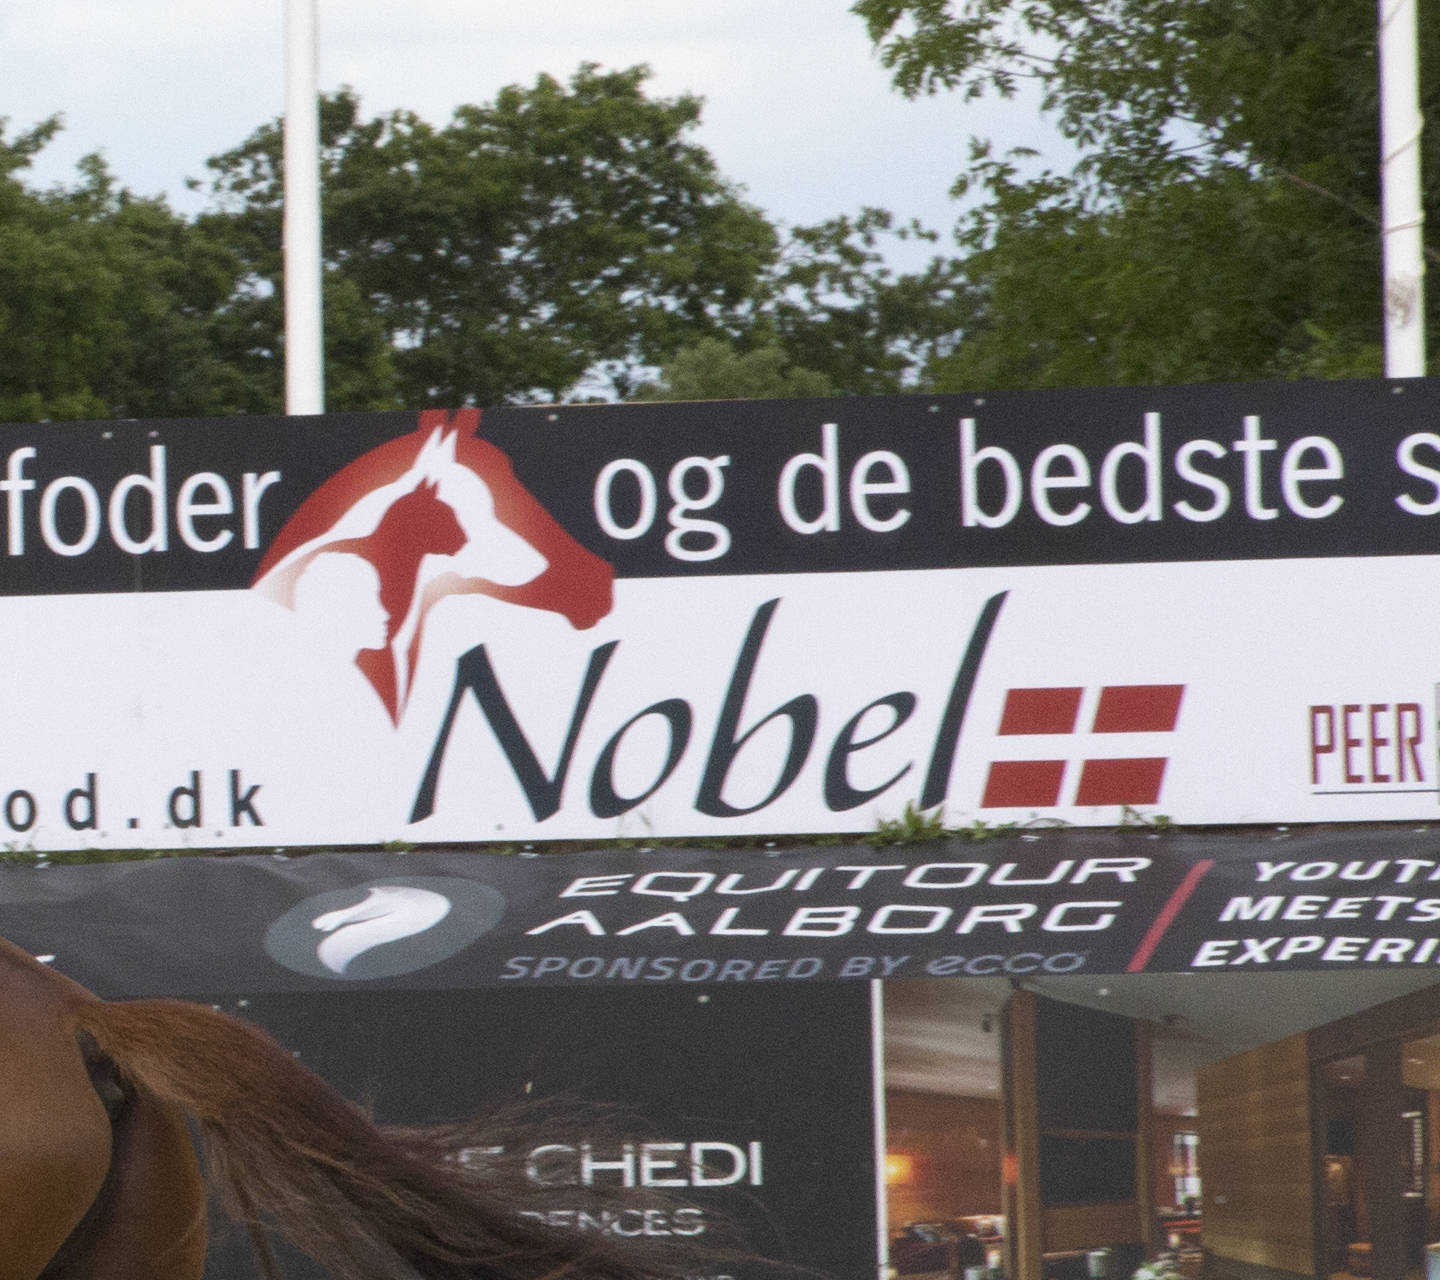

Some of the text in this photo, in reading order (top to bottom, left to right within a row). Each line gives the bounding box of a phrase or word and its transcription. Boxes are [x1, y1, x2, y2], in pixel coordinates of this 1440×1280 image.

[593, 453, 732, 563] og
[779, 422, 913, 535] de
[960, 411, 1345, 529] bedste
[408, 589, 1010, 827] Nobel
[1308, 702, 1426, 784] PEER
[559, 857, 1153, 903] EQUITOUR
[1255, 858, 1440, 883] YOUT
[524, 900, 1124, 937] AALBORG
[498, 955, 824, 983] SPONSORED
[837, 954, 912, 979] BY
[525, 1140, 764, 1188] CHEDI
